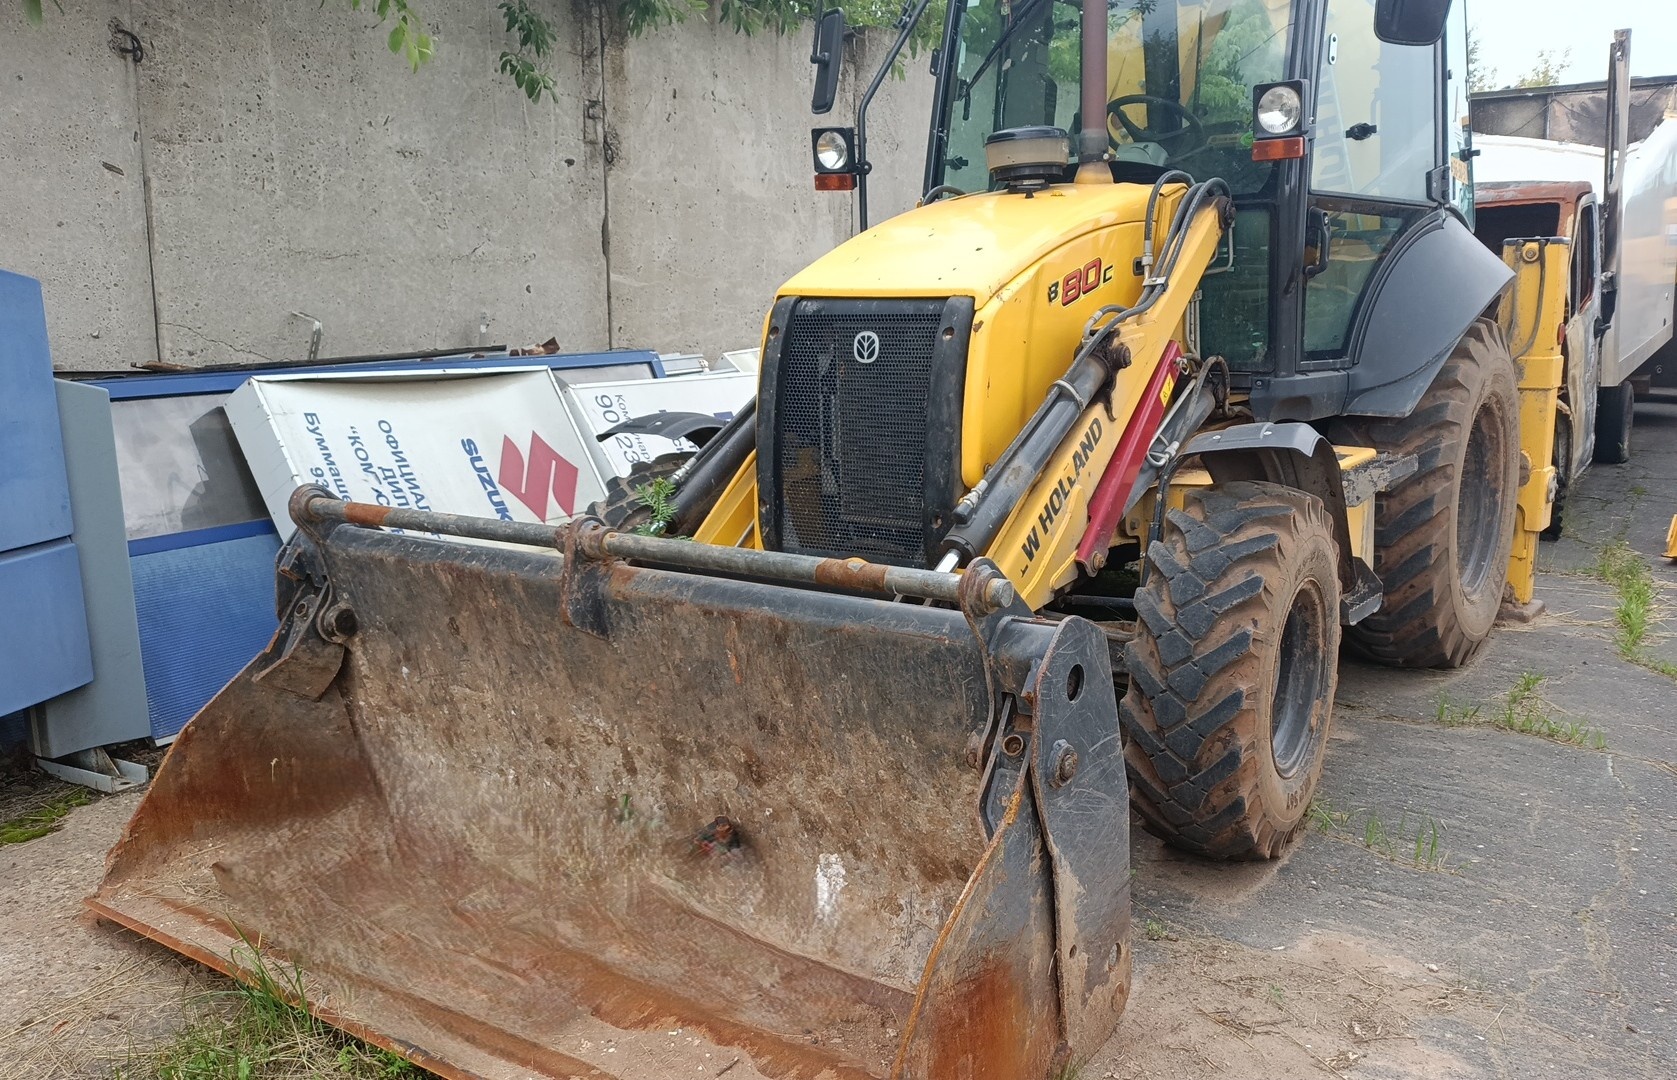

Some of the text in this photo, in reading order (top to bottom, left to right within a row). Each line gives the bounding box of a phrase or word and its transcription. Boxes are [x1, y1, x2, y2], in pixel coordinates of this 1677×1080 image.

[303, 412, 353, 502] Буммаше
[377, 466, 411, 510] ДИЛ
[378, 419, 440, 539] ОФИЦИАЛ
[461, 438, 514, 522] SUZUK
